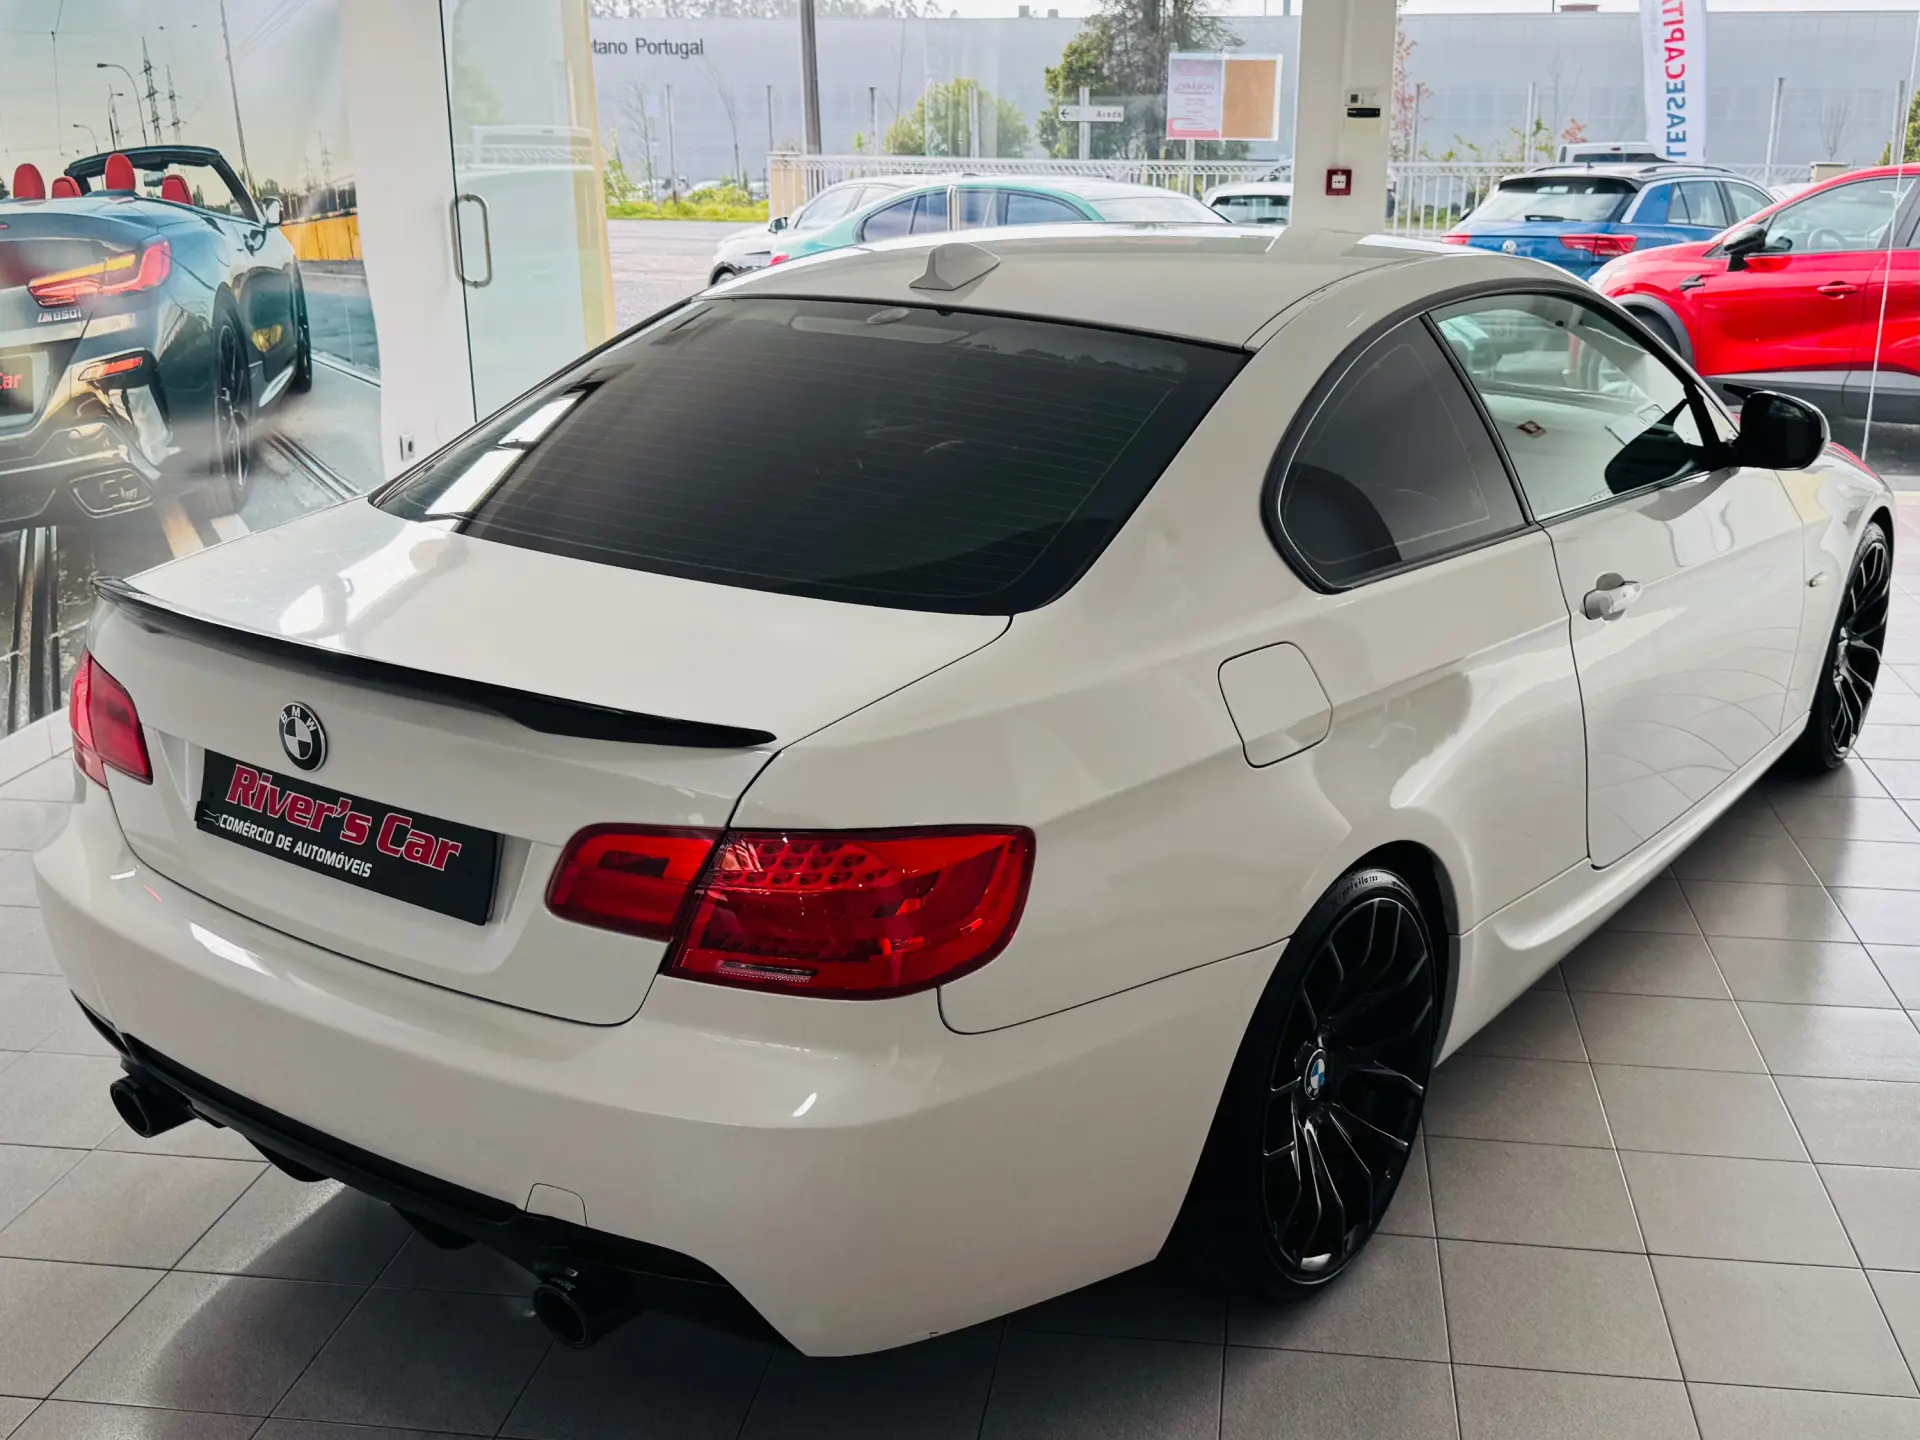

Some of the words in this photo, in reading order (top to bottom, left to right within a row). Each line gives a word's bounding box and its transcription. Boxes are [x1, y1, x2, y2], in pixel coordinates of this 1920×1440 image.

[591, 39, 628, 55] tano
[635, 37, 704, 60] Portugal
[280, 705, 317, 731] BMW
[225, 764, 373, 846] River's
[376, 812, 462, 871] Car
[219, 813, 274, 845] COMÉRCIO
[275, 833, 293, 851] DE
[293, 840, 373, 878] AUTOMÓVEIS
